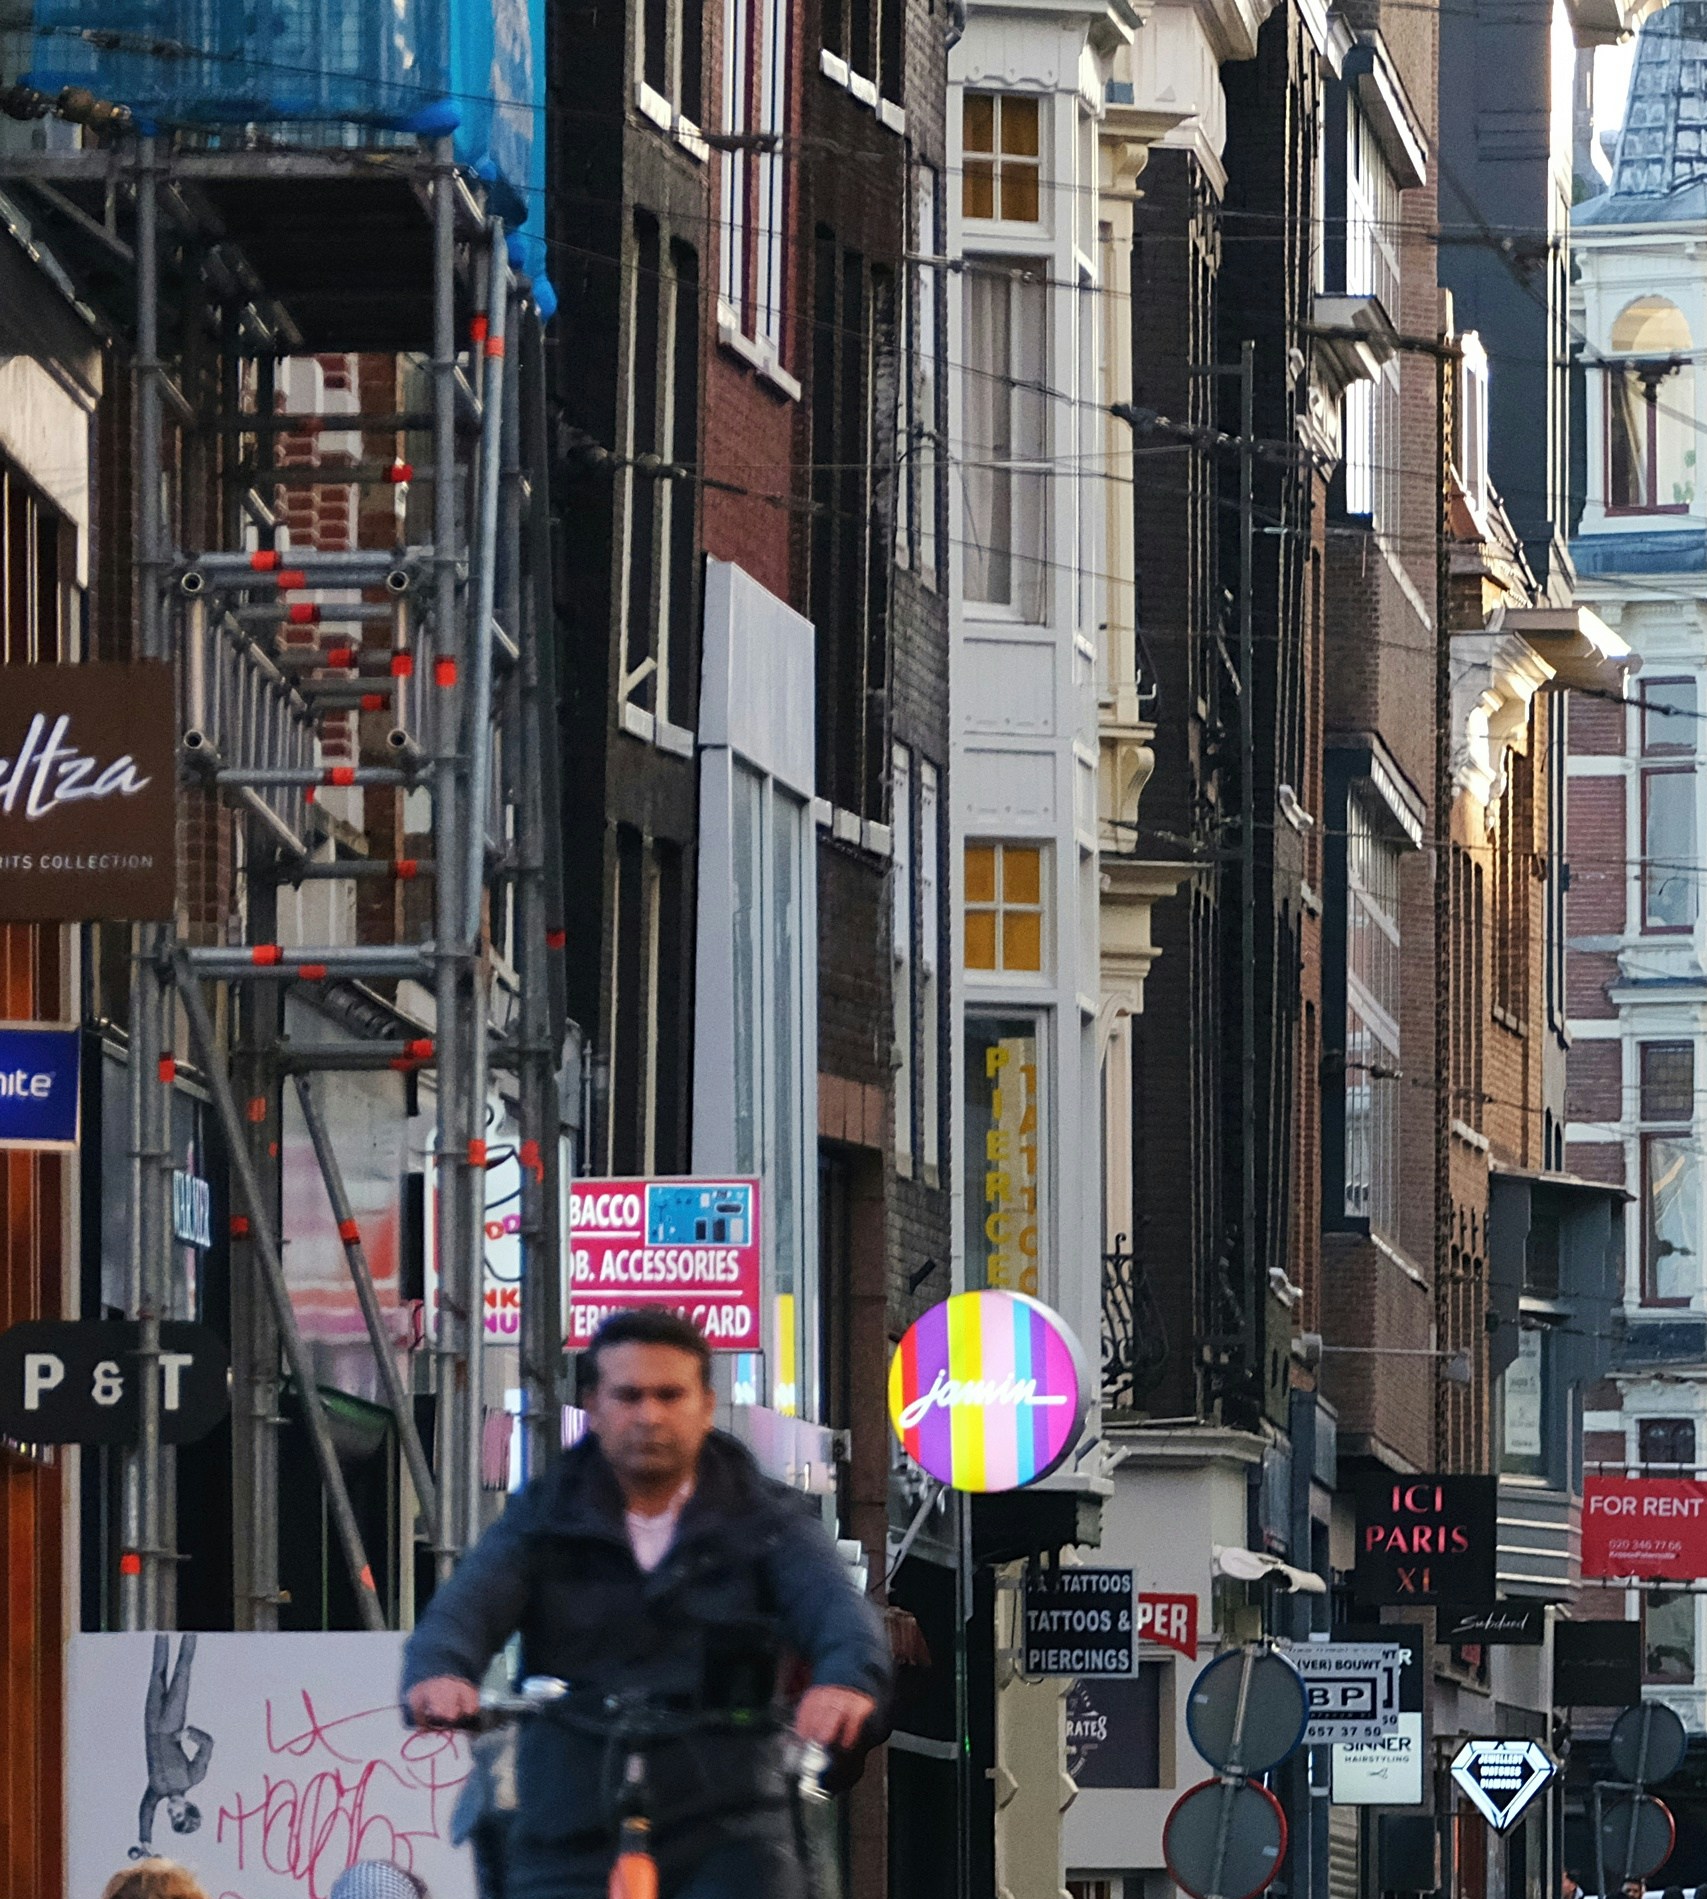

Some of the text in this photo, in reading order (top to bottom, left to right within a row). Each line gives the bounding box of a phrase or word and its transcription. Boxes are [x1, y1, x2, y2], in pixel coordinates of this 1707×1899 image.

[0, 713, 152, 818] ltza
[0, 855, 153, 870] ITS COLLECTION
[600, 1249, 740, 1283] ACCESSORIES
[24, 1354, 194, 1410] P & T
[898, 1368, 1067, 1429] jamin
[1392, 1485, 1443, 1513] ICI
[1590, 1495, 1705, 1518] FOR RENT
[1366, 1525, 1469, 1554] PARIS
[1061, 1574, 1131, 1594] TATTOOS
[1397, 1567, 1438, 1594] XL
[1027, 1609, 1131, 1633] TATTOOS &
[1028, 1649, 1130, 1672] PIERCINGS
[1335, 1659, 1382, 1671] BOUWT
